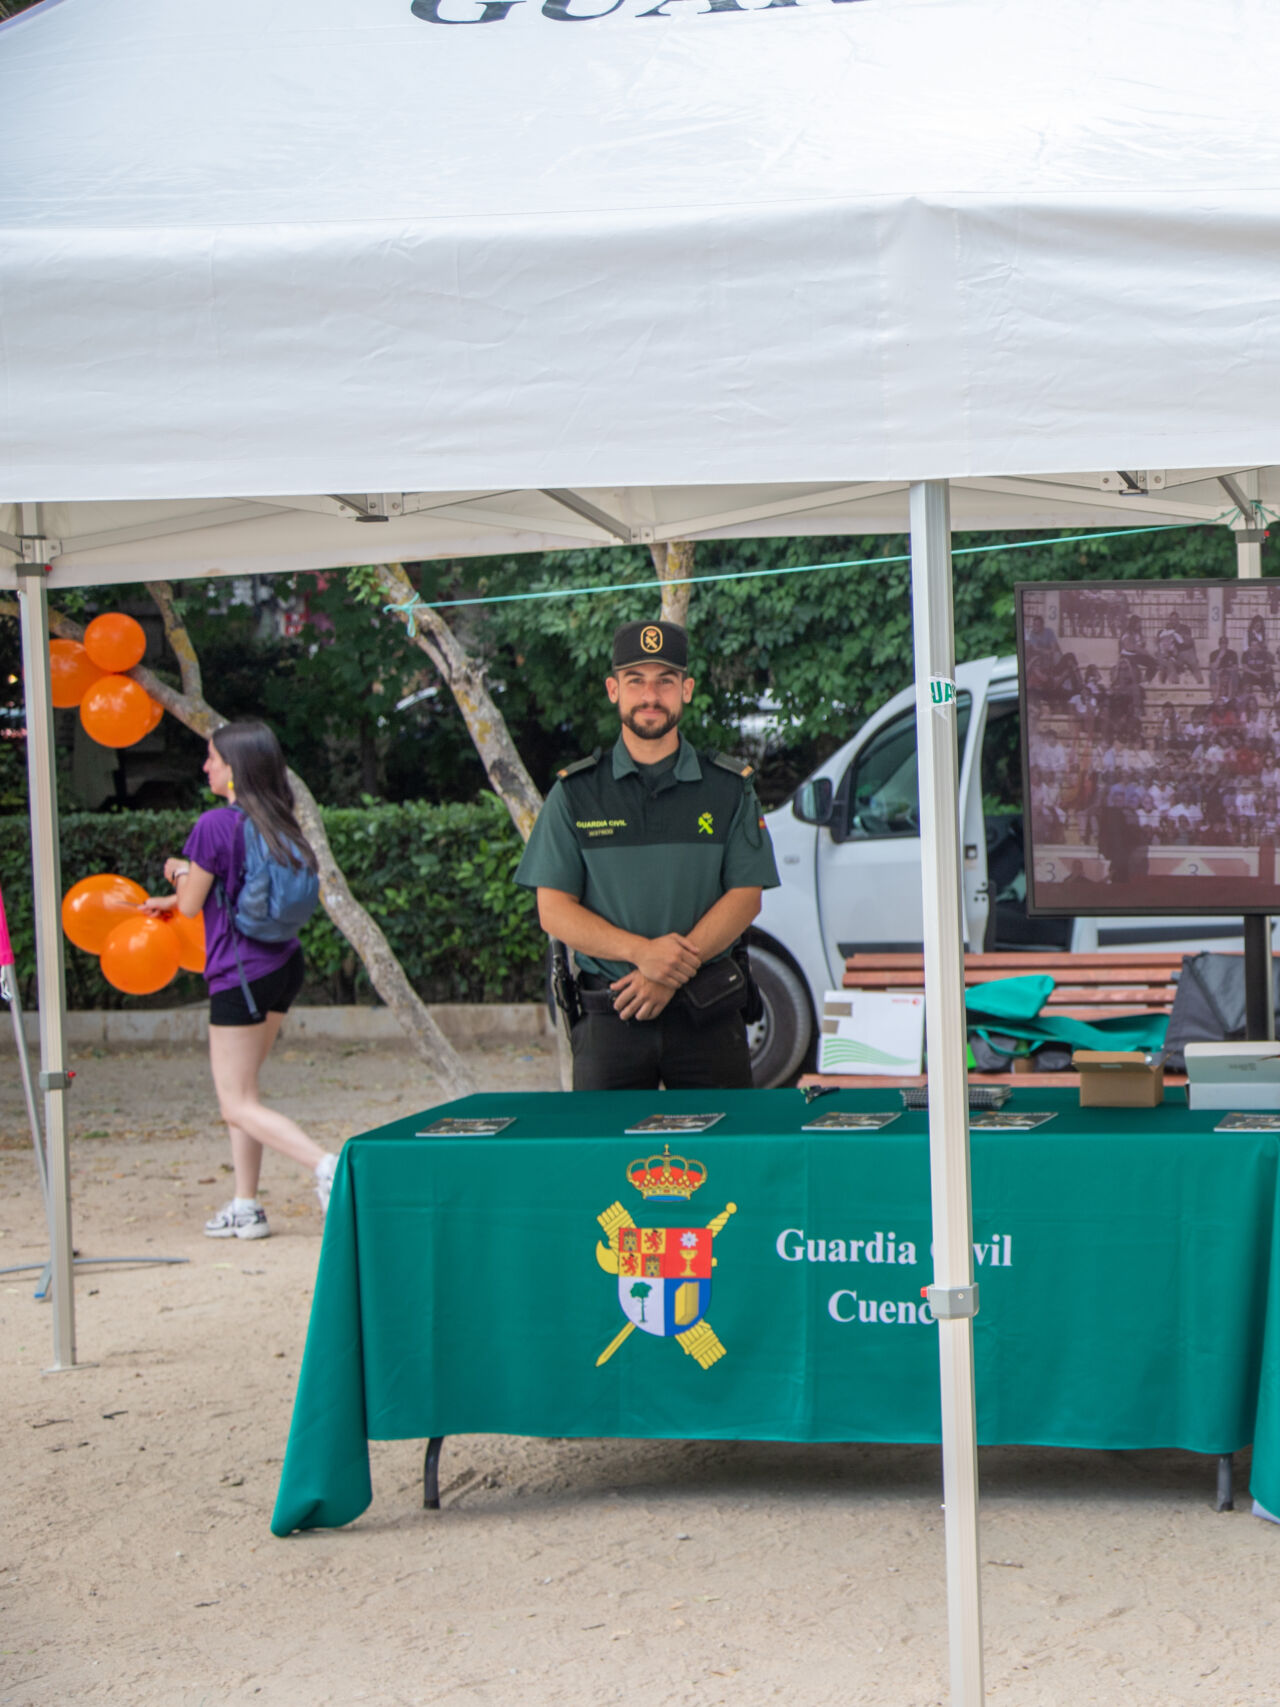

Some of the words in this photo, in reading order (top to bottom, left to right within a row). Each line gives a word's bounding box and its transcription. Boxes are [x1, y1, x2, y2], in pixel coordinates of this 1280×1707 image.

[1211, 606, 1221, 622] 3
[576, 820, 607, 828] GUARDIA
[608, 819, 627, 827] CIVIL
[1045, 862, 1056, 882] 3
[776, 1228, 918, 1265] Guardia
[930, 1234, 1013, 1267] vil
[828, 1289, 937, 1325] Cuenc
